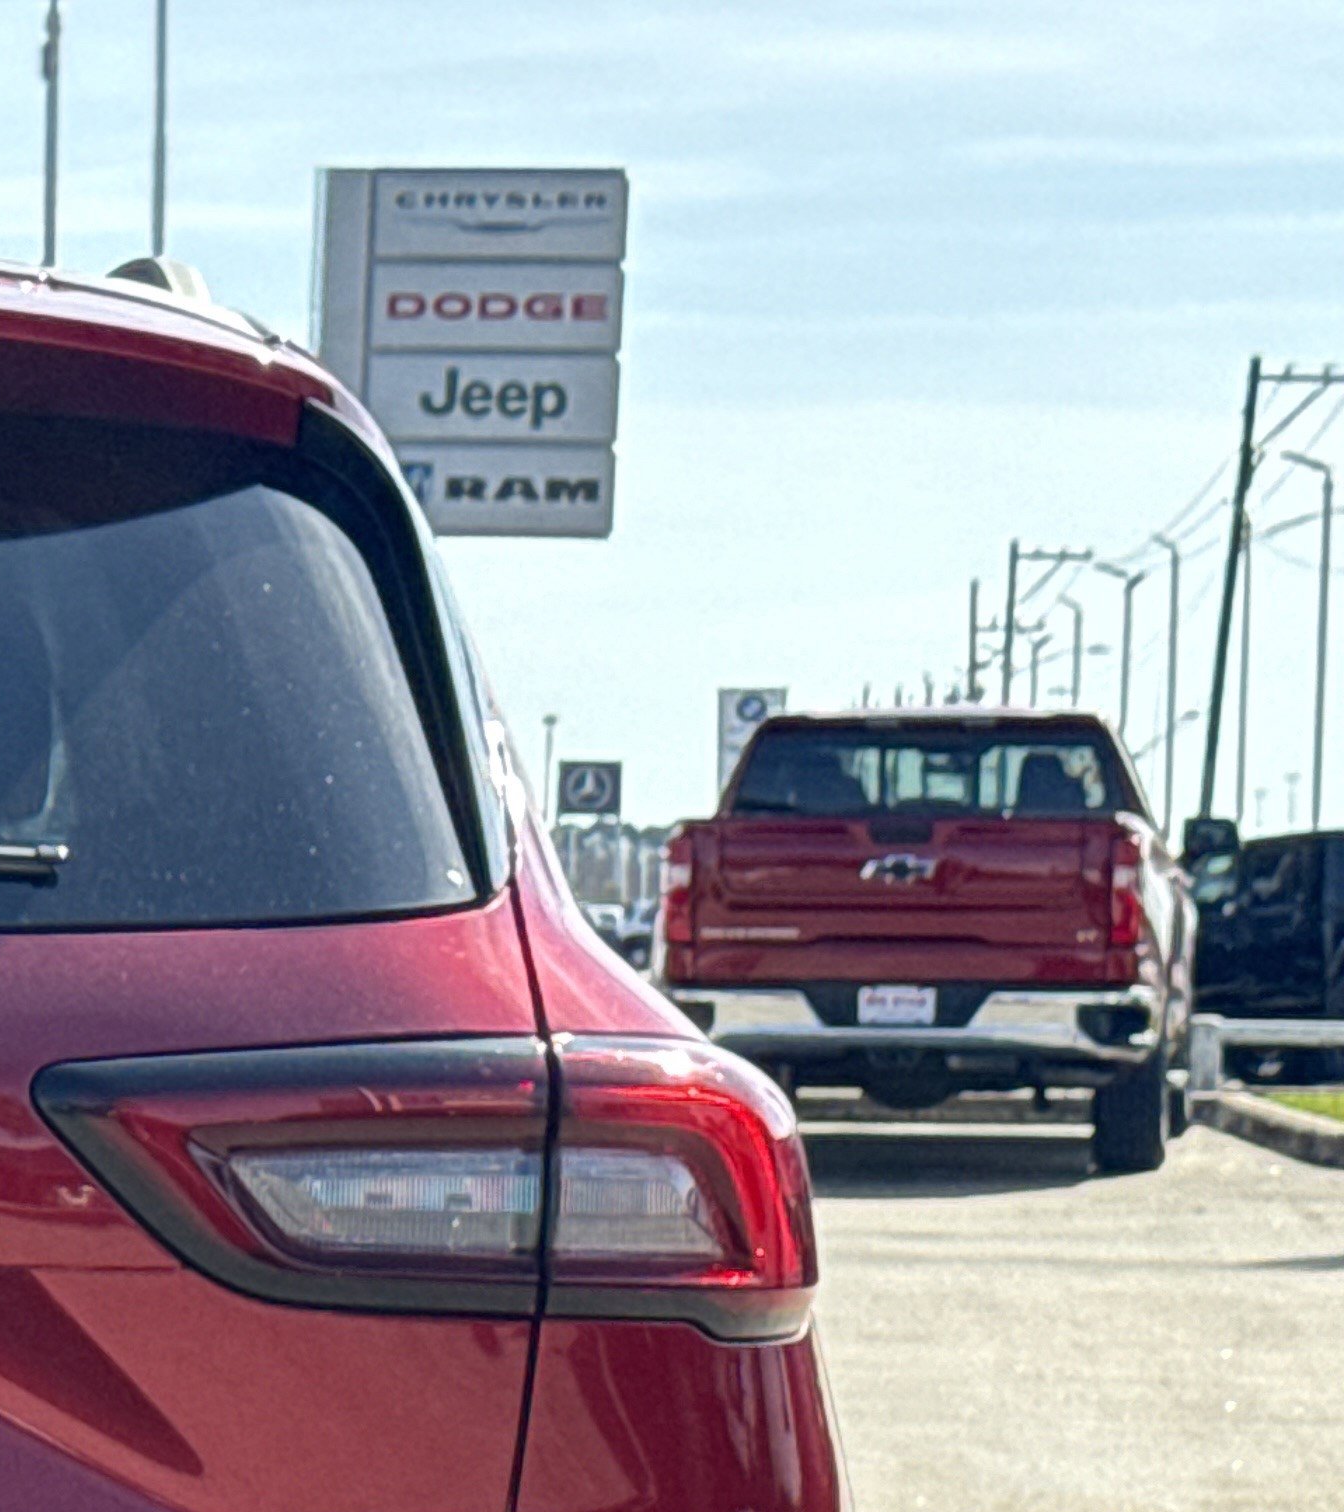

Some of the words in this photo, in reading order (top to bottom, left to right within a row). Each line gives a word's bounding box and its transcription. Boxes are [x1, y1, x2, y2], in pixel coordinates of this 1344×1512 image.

[395, 190, 608, 210] CHRYSLER
[387, 292, 608, 322] DODGE
[419, 366, 568, 430] Jeep
[444, 476, 601, 501] RAM
